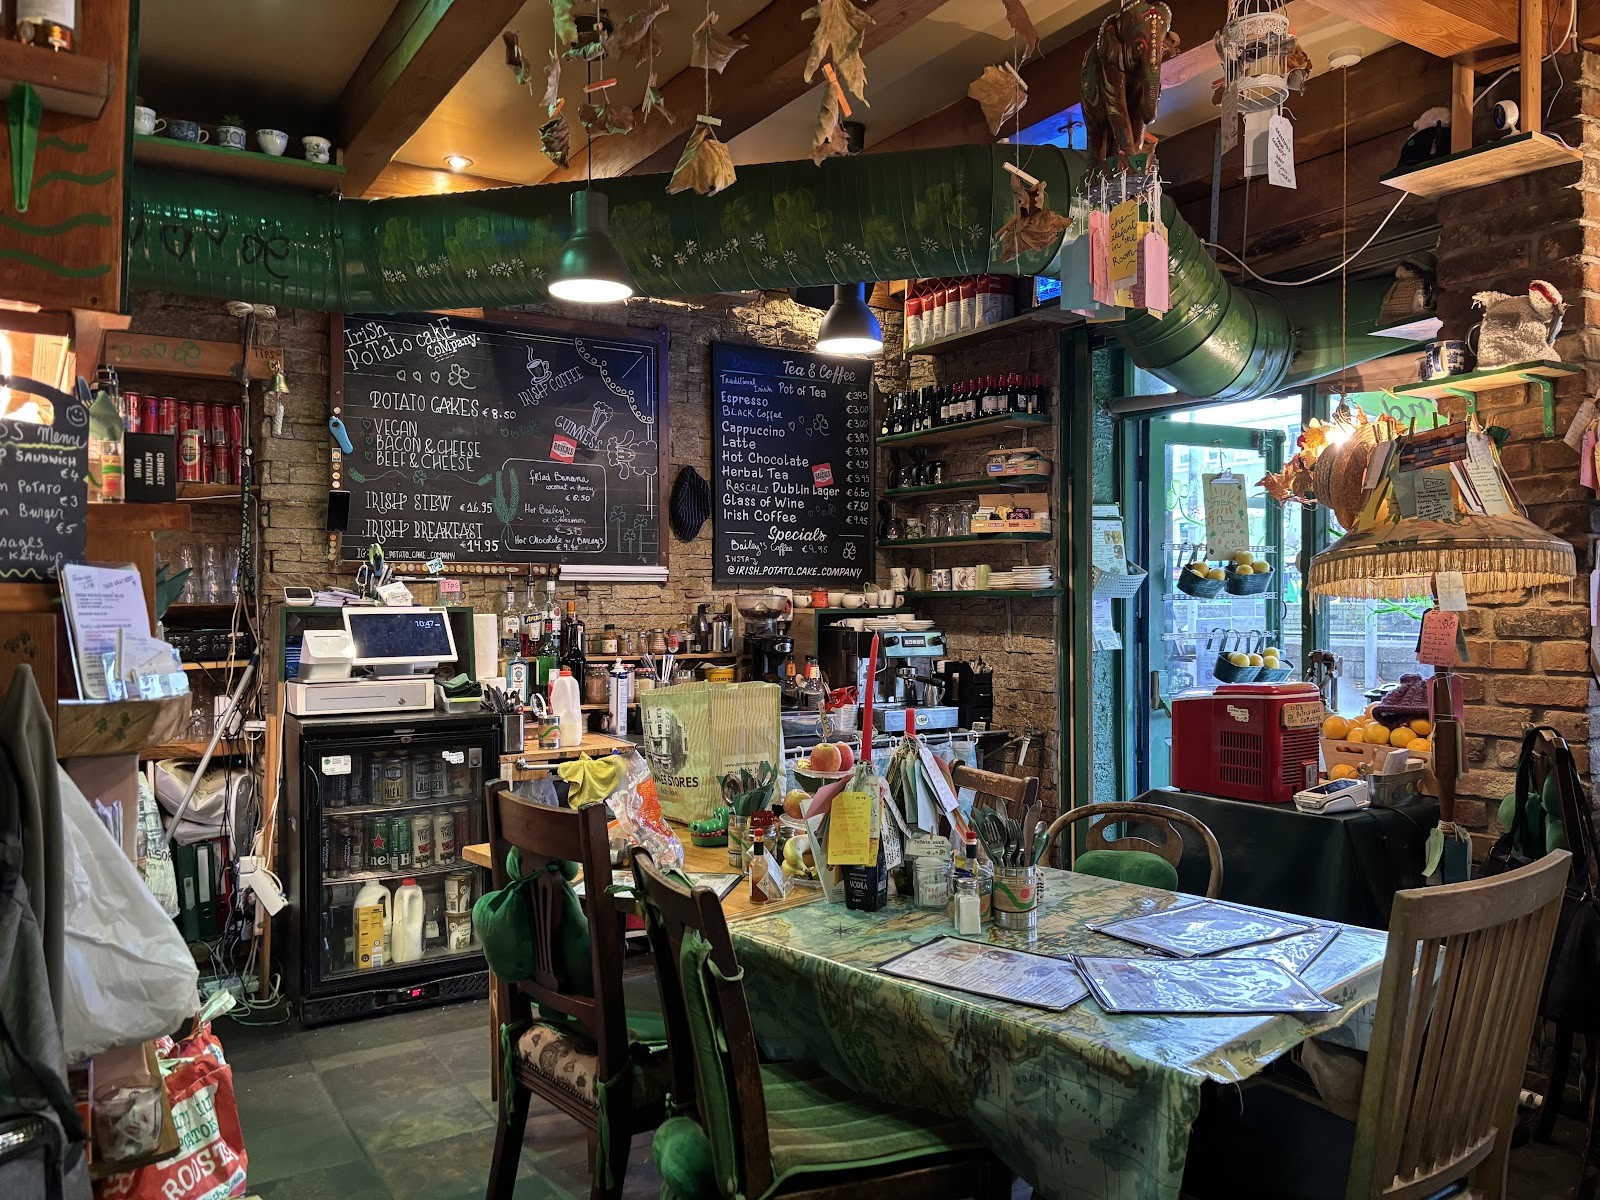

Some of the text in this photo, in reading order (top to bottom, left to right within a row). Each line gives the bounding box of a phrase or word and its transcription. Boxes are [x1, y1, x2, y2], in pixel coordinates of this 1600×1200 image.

[783, 360, 806, 376] Tea
[819, 364, 856, 385] Coffee
[518, 366, 584, 407] IRISH COFFEE
[778, 382, 794, 395] Pot
[796, 386, 806, 396] of
[809, 386, 827, 398] Tea
[369, 391, 426, 412] POTATO
[430, 396, 479, 417] CAKES
[721, 391, 768, 407] Espresso
[757, 408, 783, 421] Coffee
[374, 418, 418, 437] VEGAN
[555, 416, 602, 451] GUINNESS
[722, 421, 786, 437] Cappuccino
[376, 435, 482, 458] BACON & CHEESE
[722, 435, 756, 449] Latte
[376, 451, 475, 472] BEEF & CHEESE
[722, 450, 744, 463] Hot
[748, 453, 809, 467] Chocolate
[134, 458, 142, 479] POUR
[145, 451, 154, 486] ACTIVATE
[156, 452, 165, 486] CONNECT
[722, 466, 763, 478] Herbal
[767, 468, 789, 480] Tea
[772, 482, 810, 495] Dublin
[812, 485, 840, 500] Lager
[365, 491, 408, 514] IRISH
[414, 494, 452, 511] STEW
[722, 494, 756, 507] Glass
[760, 496, 771, 508] of
[775, 497, 805, 509] Wine
[723, 508, 749, 521] Irish
[364, 519, 409, 544] IRISH
[413, 520, 483, 542] BREAKFAST
[767, 526, 827, 544] Specials
[849, 880, 868, 890] VODKA
[1015, 1074, 1050, 1086] SOUTH
[1055, 1086, 1100, 1126] PACIFIC
[1105, 1128, 1145, 1155] OCEAN
